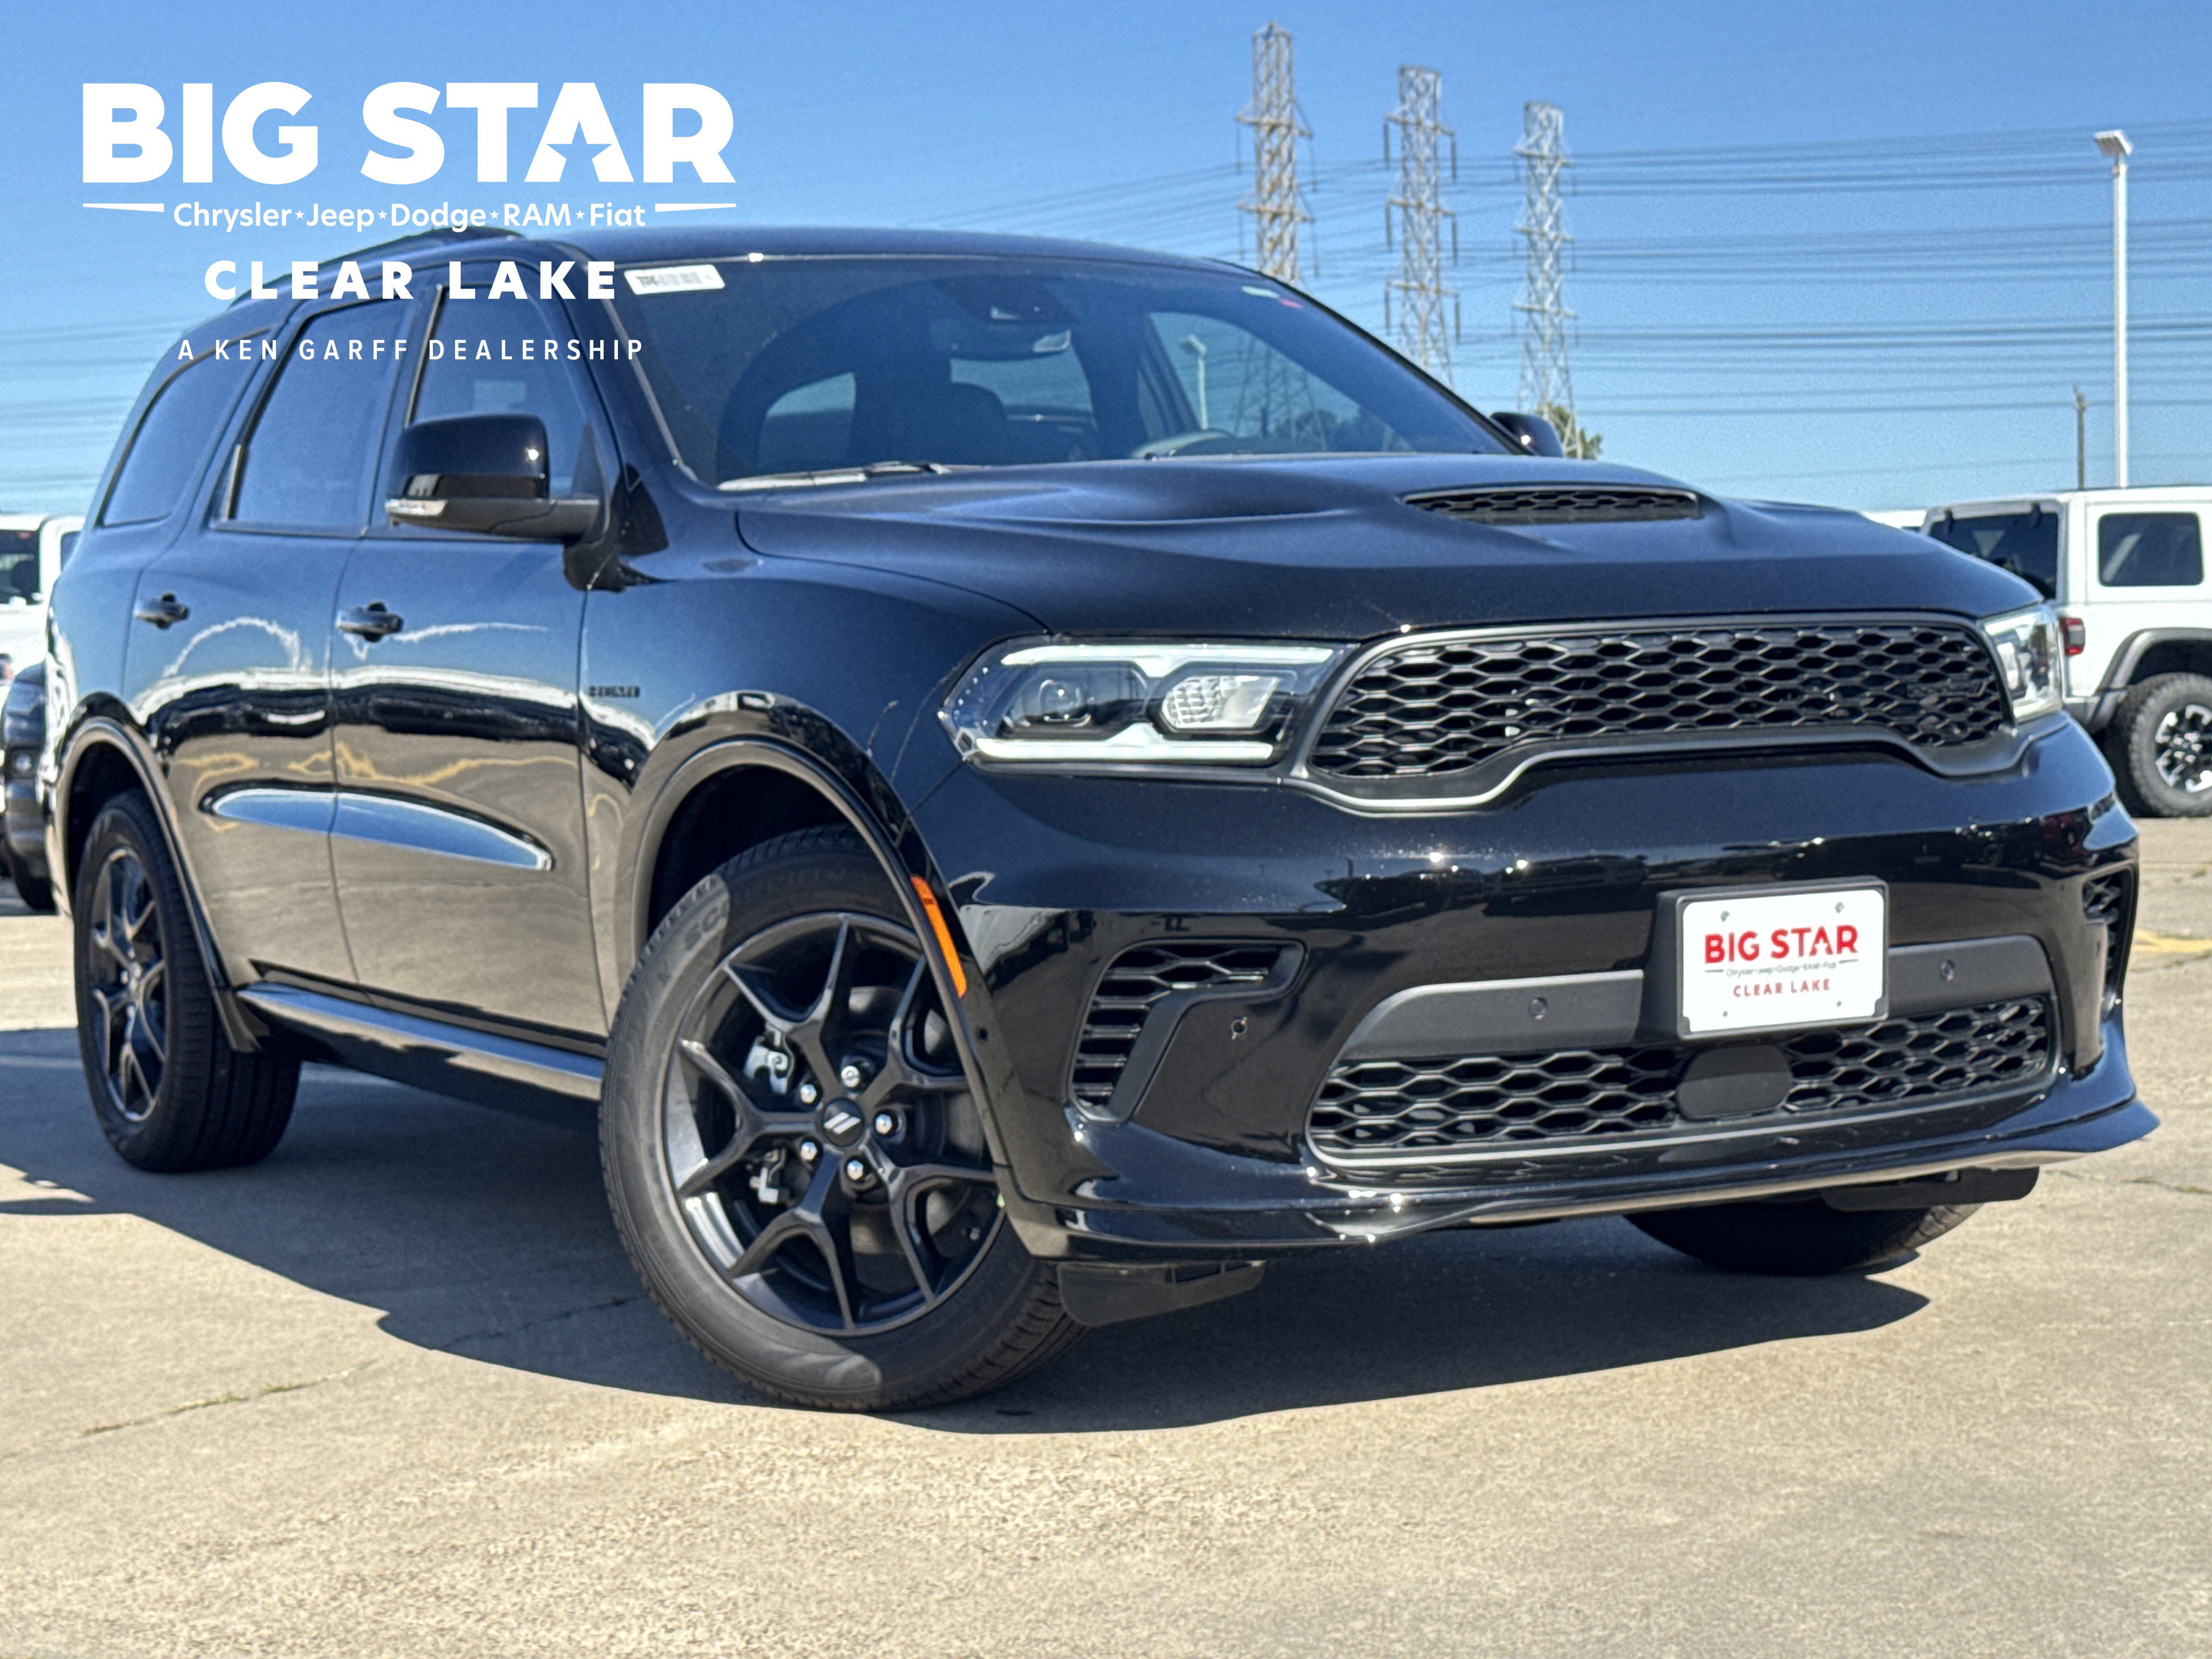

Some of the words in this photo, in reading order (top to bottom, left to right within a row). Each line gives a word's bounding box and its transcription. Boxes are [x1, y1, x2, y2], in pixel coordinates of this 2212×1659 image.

[1705, 930, 1759, 963] BIG
[1771, 924, 1858, 959] STAR
[1733, 981, 1783, 998] CLEAR
[1791, 978, 1830, 994] LAKE
